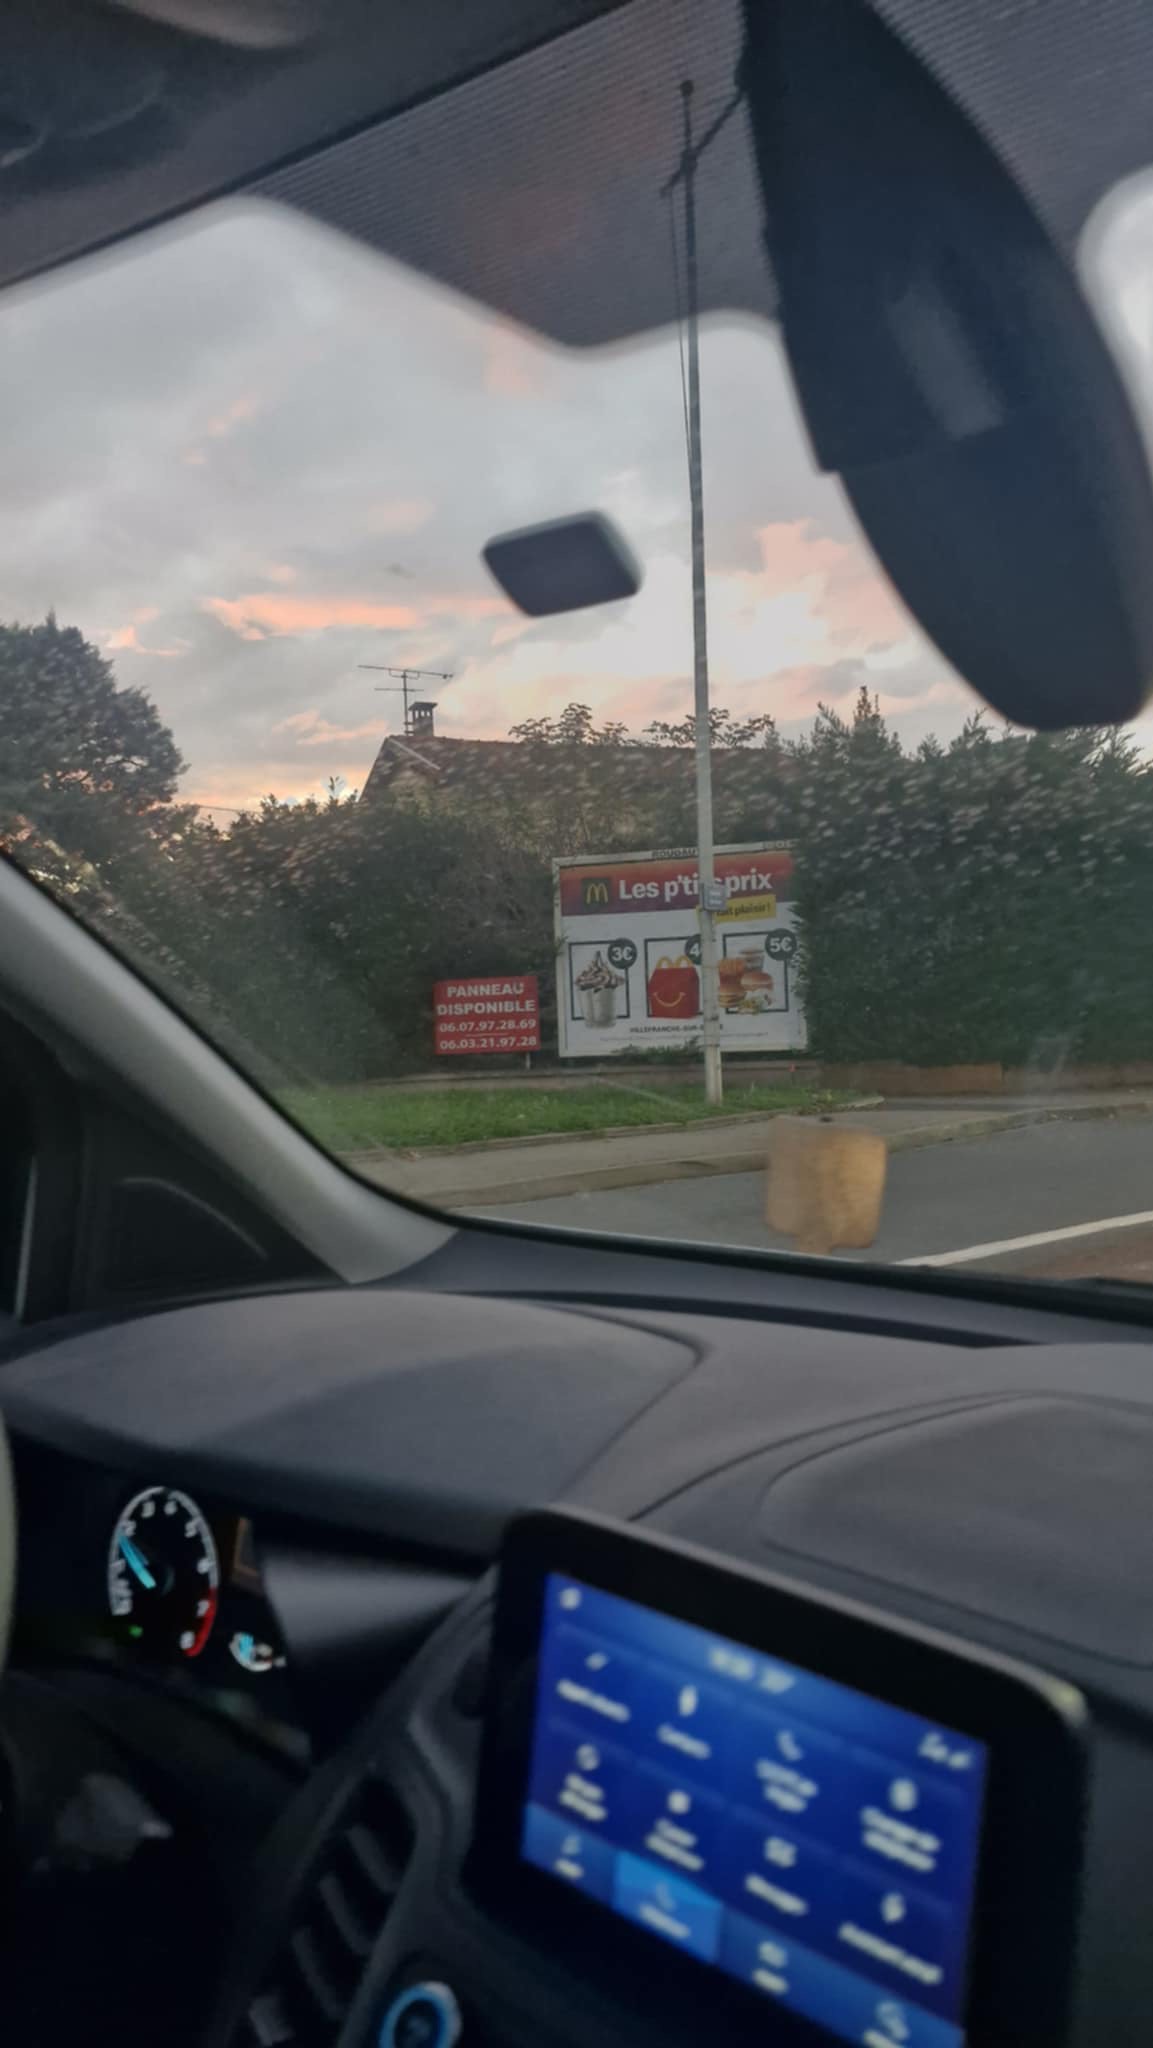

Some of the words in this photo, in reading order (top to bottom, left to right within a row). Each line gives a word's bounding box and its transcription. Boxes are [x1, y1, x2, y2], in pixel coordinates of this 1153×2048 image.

[619, 879, 660, 899] Les
[664, 872, 723, 903] p'ti
[725, 867, 772, 898] prix
[689, 943, 701, 955] 4
[769, 936, 792, 952] 5€
[611, 946, 633, 961] 3€
[447, 983, 524, 998] PANNEAU
[436, 1000, 536, 1016] DISPONIBLE
[439, 1019, 537, 1033] 06.07.97.28.69
[440, 1036, 537, 1050] 06.03.21.97.28
